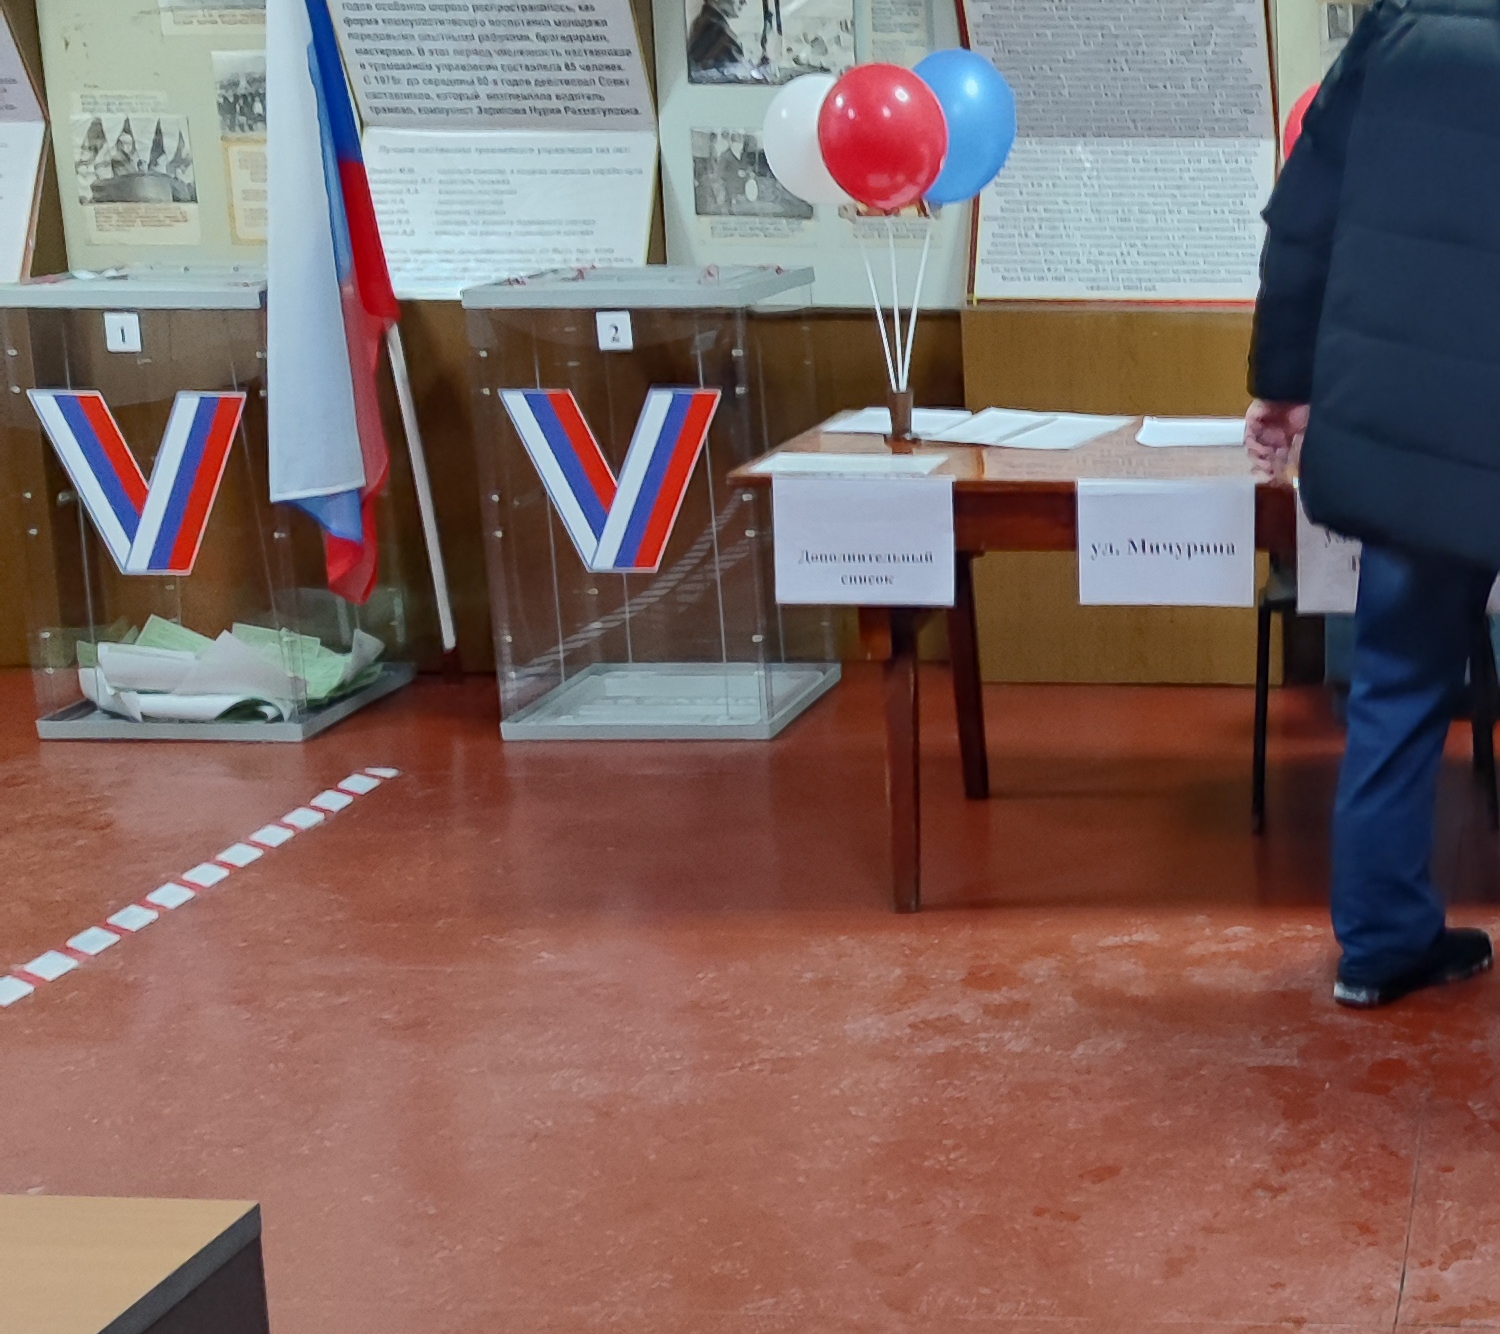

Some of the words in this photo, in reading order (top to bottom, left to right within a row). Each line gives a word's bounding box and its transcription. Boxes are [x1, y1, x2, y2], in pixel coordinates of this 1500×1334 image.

[609, 323, 621, 343] 2
[797, 549, 934, 566] Дополнительный
[1091, 540, 1119, 560] ул.
[1127, 538, 1236, 560] Мичурина
[840, 574, 894, 585] список
